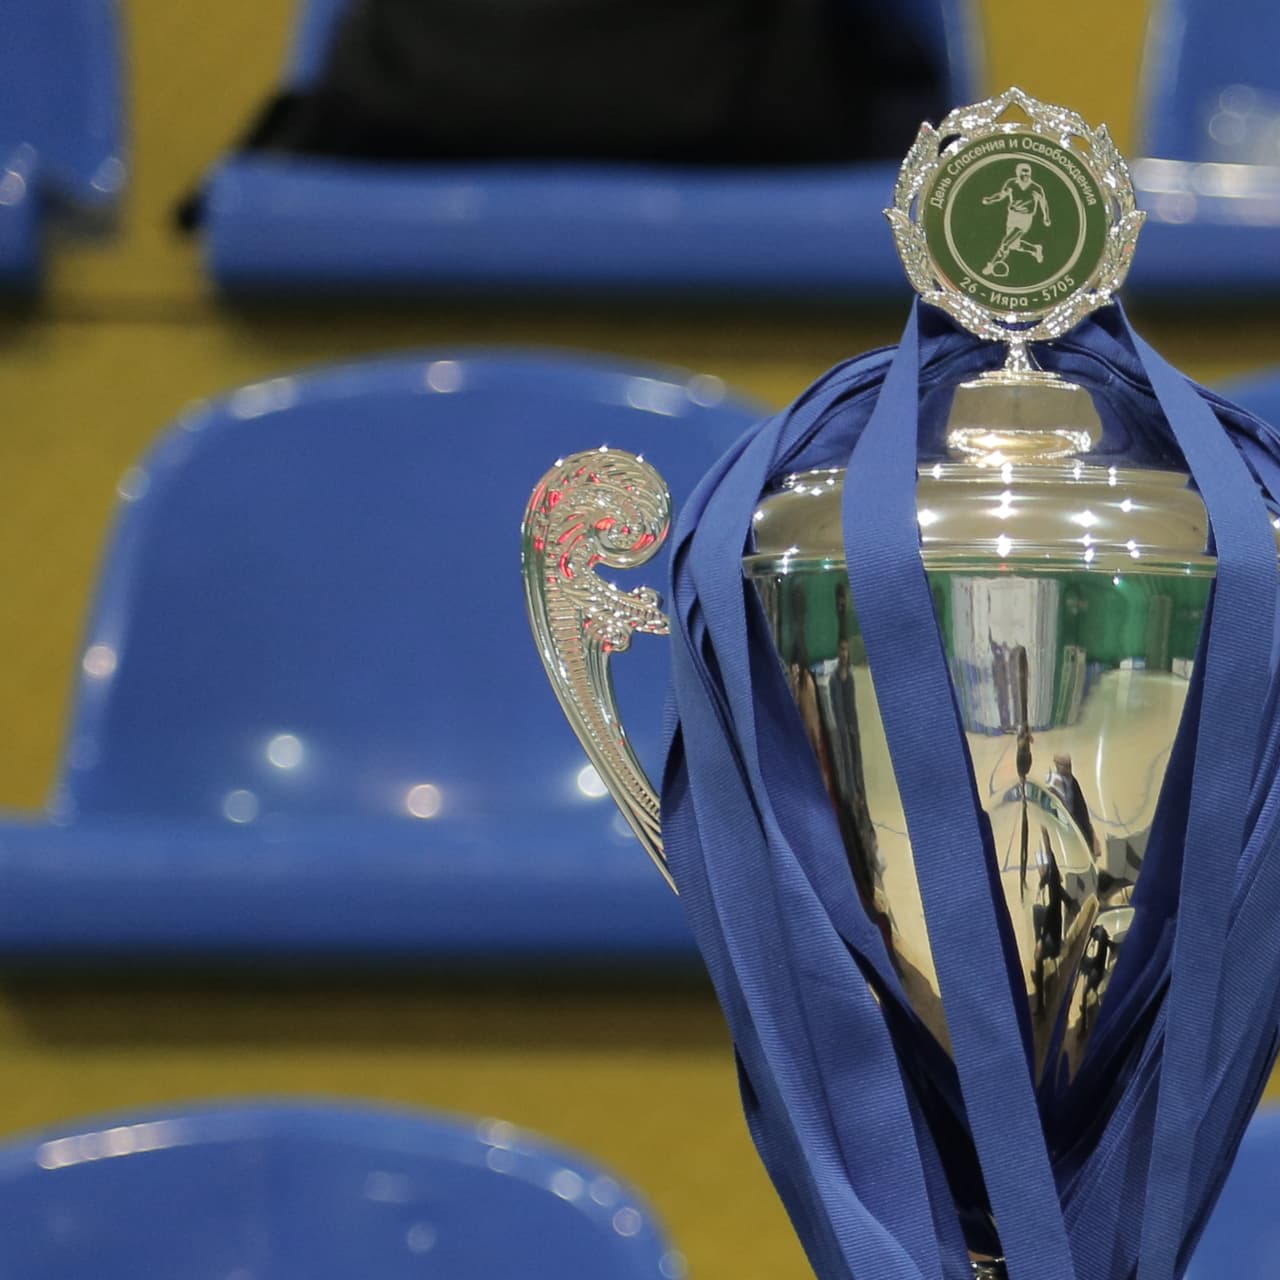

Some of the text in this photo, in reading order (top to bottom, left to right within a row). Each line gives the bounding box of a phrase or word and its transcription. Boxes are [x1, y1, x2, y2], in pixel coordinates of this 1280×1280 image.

[930, 137, 1097, 209] День Спасения и Освобождения
[959, 276, 977, 293] 26
[990, 291, 1028, 309] Ияра
[1042, 274, 1075, 301] 5705
